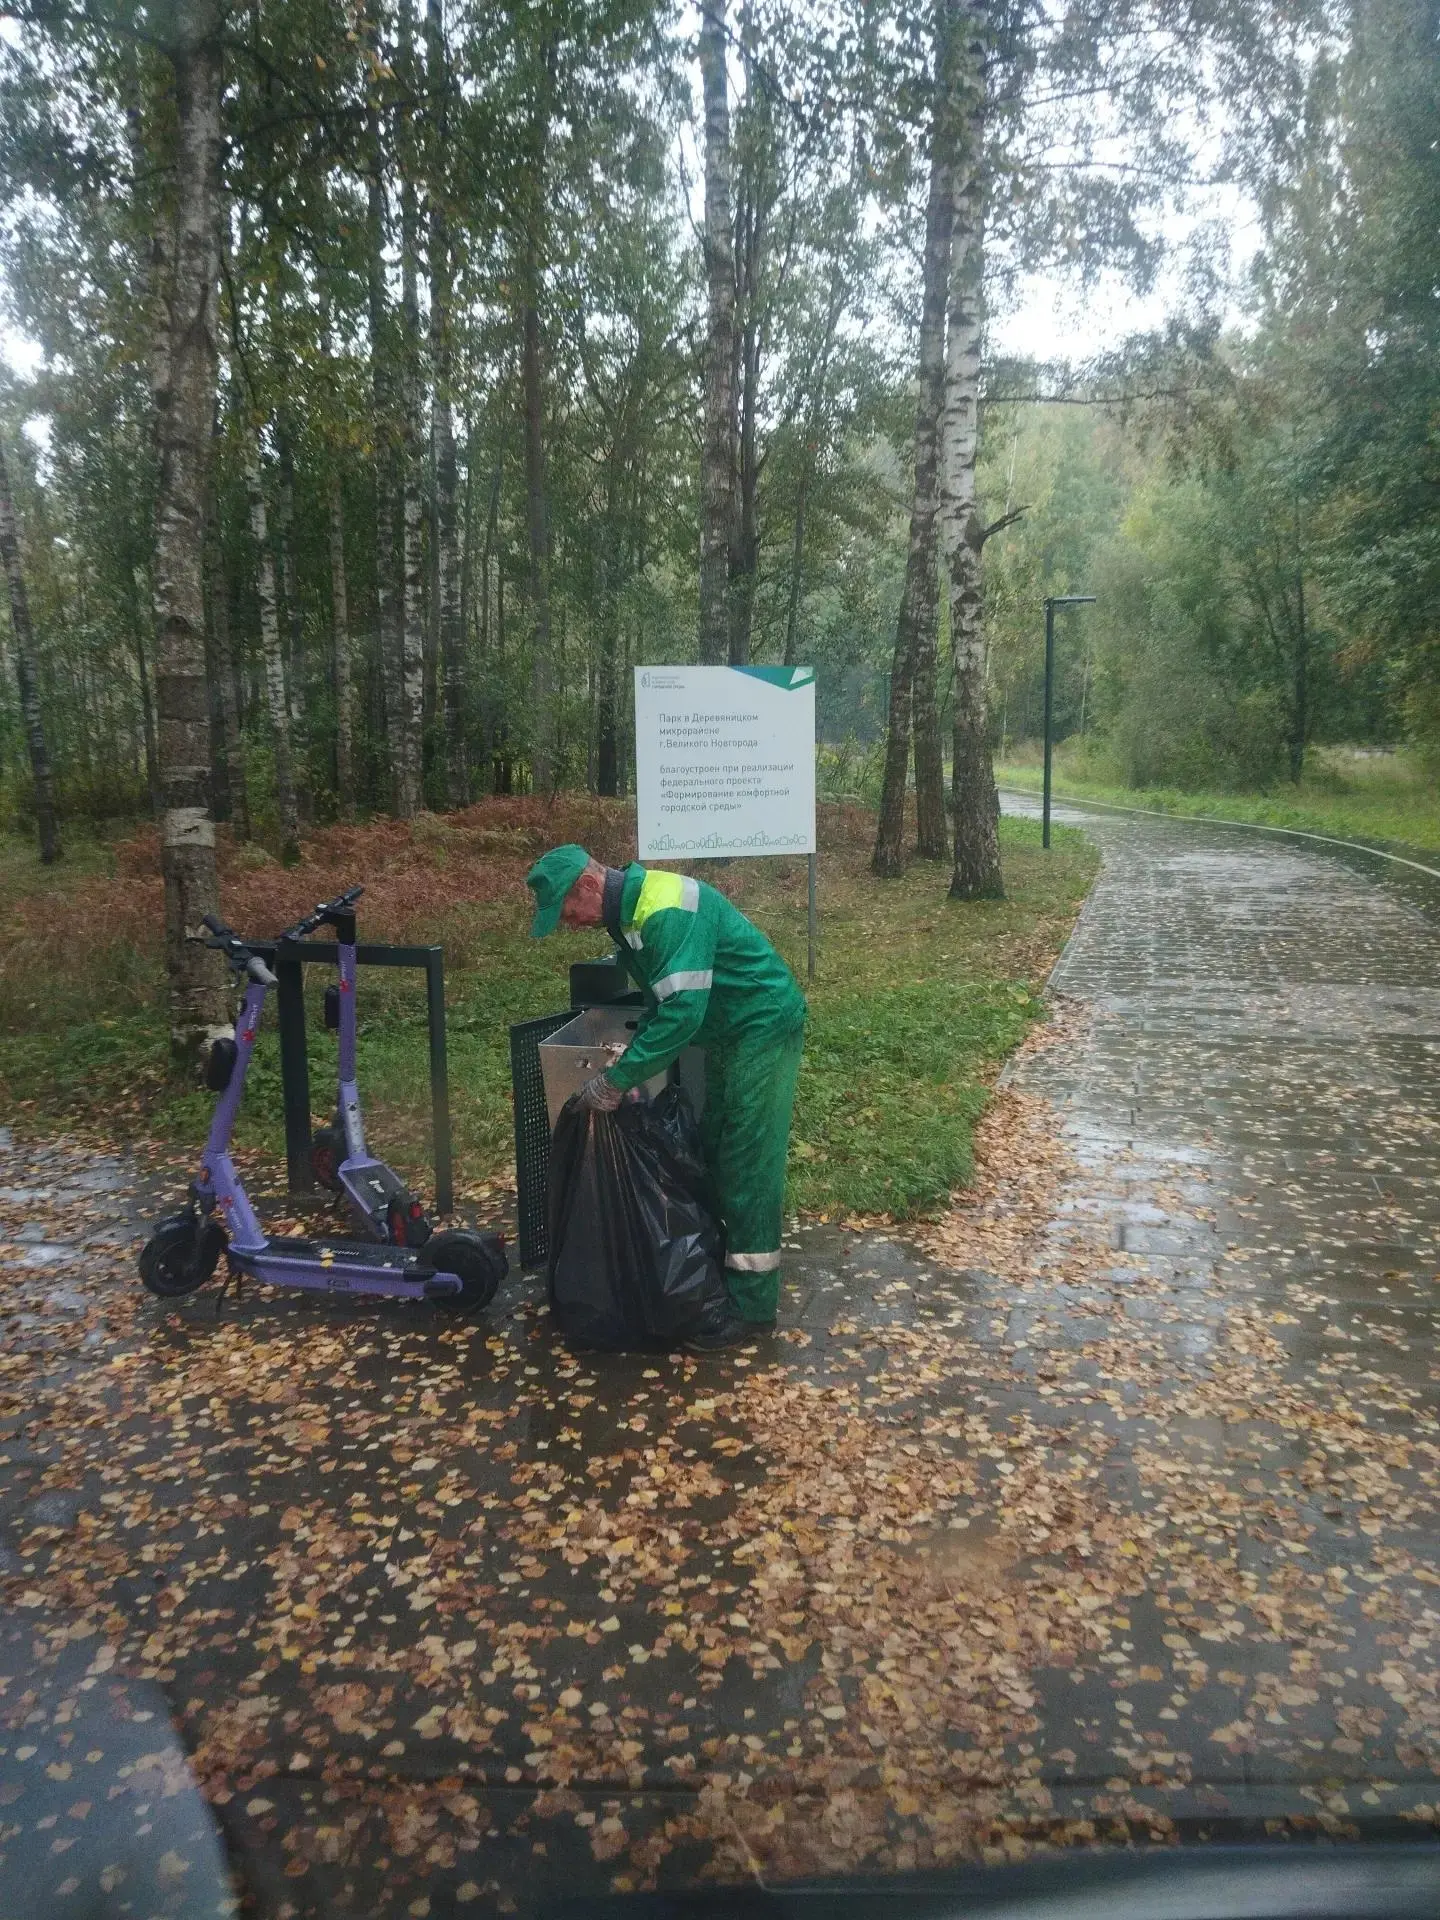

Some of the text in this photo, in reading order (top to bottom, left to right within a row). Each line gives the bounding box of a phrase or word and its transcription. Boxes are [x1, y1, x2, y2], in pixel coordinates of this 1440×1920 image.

[659, 713, 682, 724] Парк
[692, 713, 758, 724] Деревяницком
[659, 727, 720, 737] микрорайоне
[711, 738, 758, 748] Новгорода
[660, 763, 794, 775] благоустроен при реализации
[660, 777, 761, 788] федерального проекта
[660, 788, 790, 800] «Формирование комфортной
[660, 803, 742, 813] городской среды»
